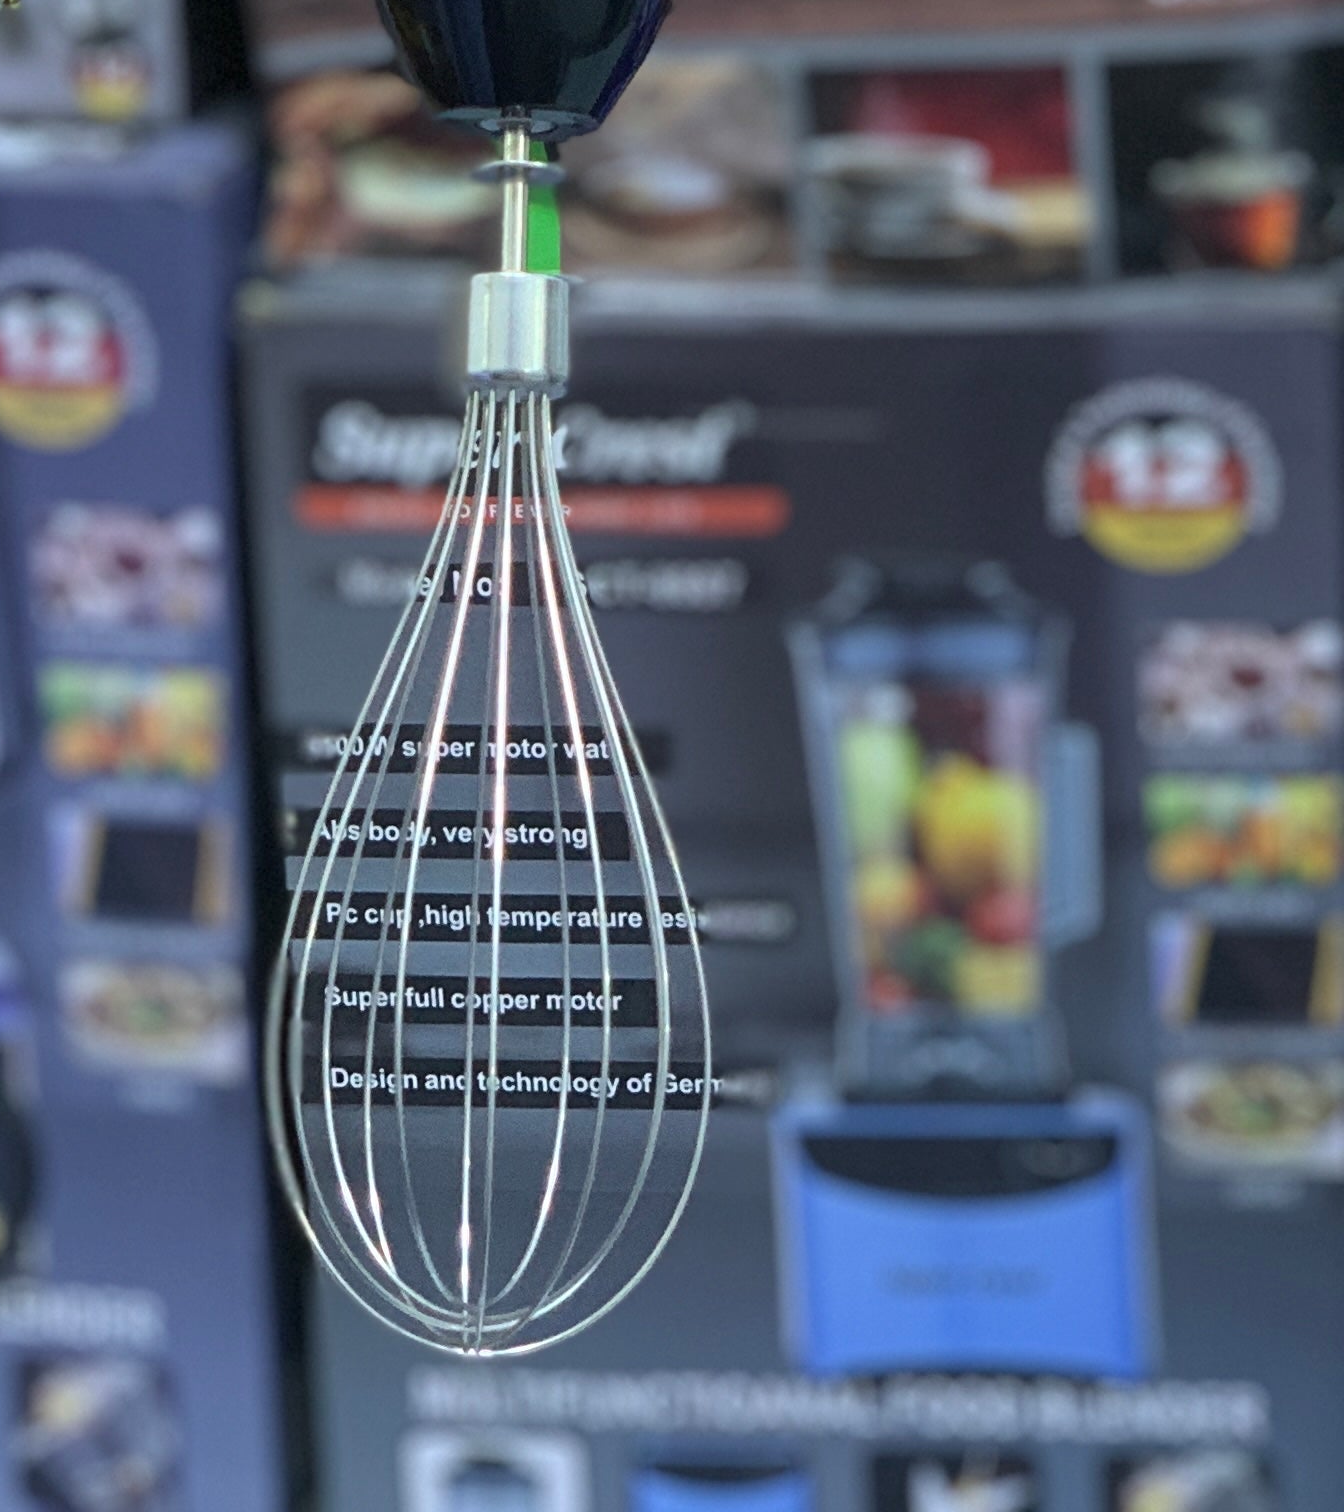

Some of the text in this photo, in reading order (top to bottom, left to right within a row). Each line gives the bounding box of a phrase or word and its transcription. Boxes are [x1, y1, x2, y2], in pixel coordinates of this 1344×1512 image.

[368, 820, 436, 846] body,
[443, 824, 495, 847] very
[505, 823, 588, 849] strong
[326, 902, 359, 924] Pc
[364, 907, 413, 929] cup
[488, 905, 643, 931] temperature
[325, 986, 623, 1015] Super full copper motor
[330, 1067, 419, 1094] Design
[424, 1070, 472, 1090] and
[476, 1071, 620, 1098] technology
[626, 1073, 653, 1093] of
